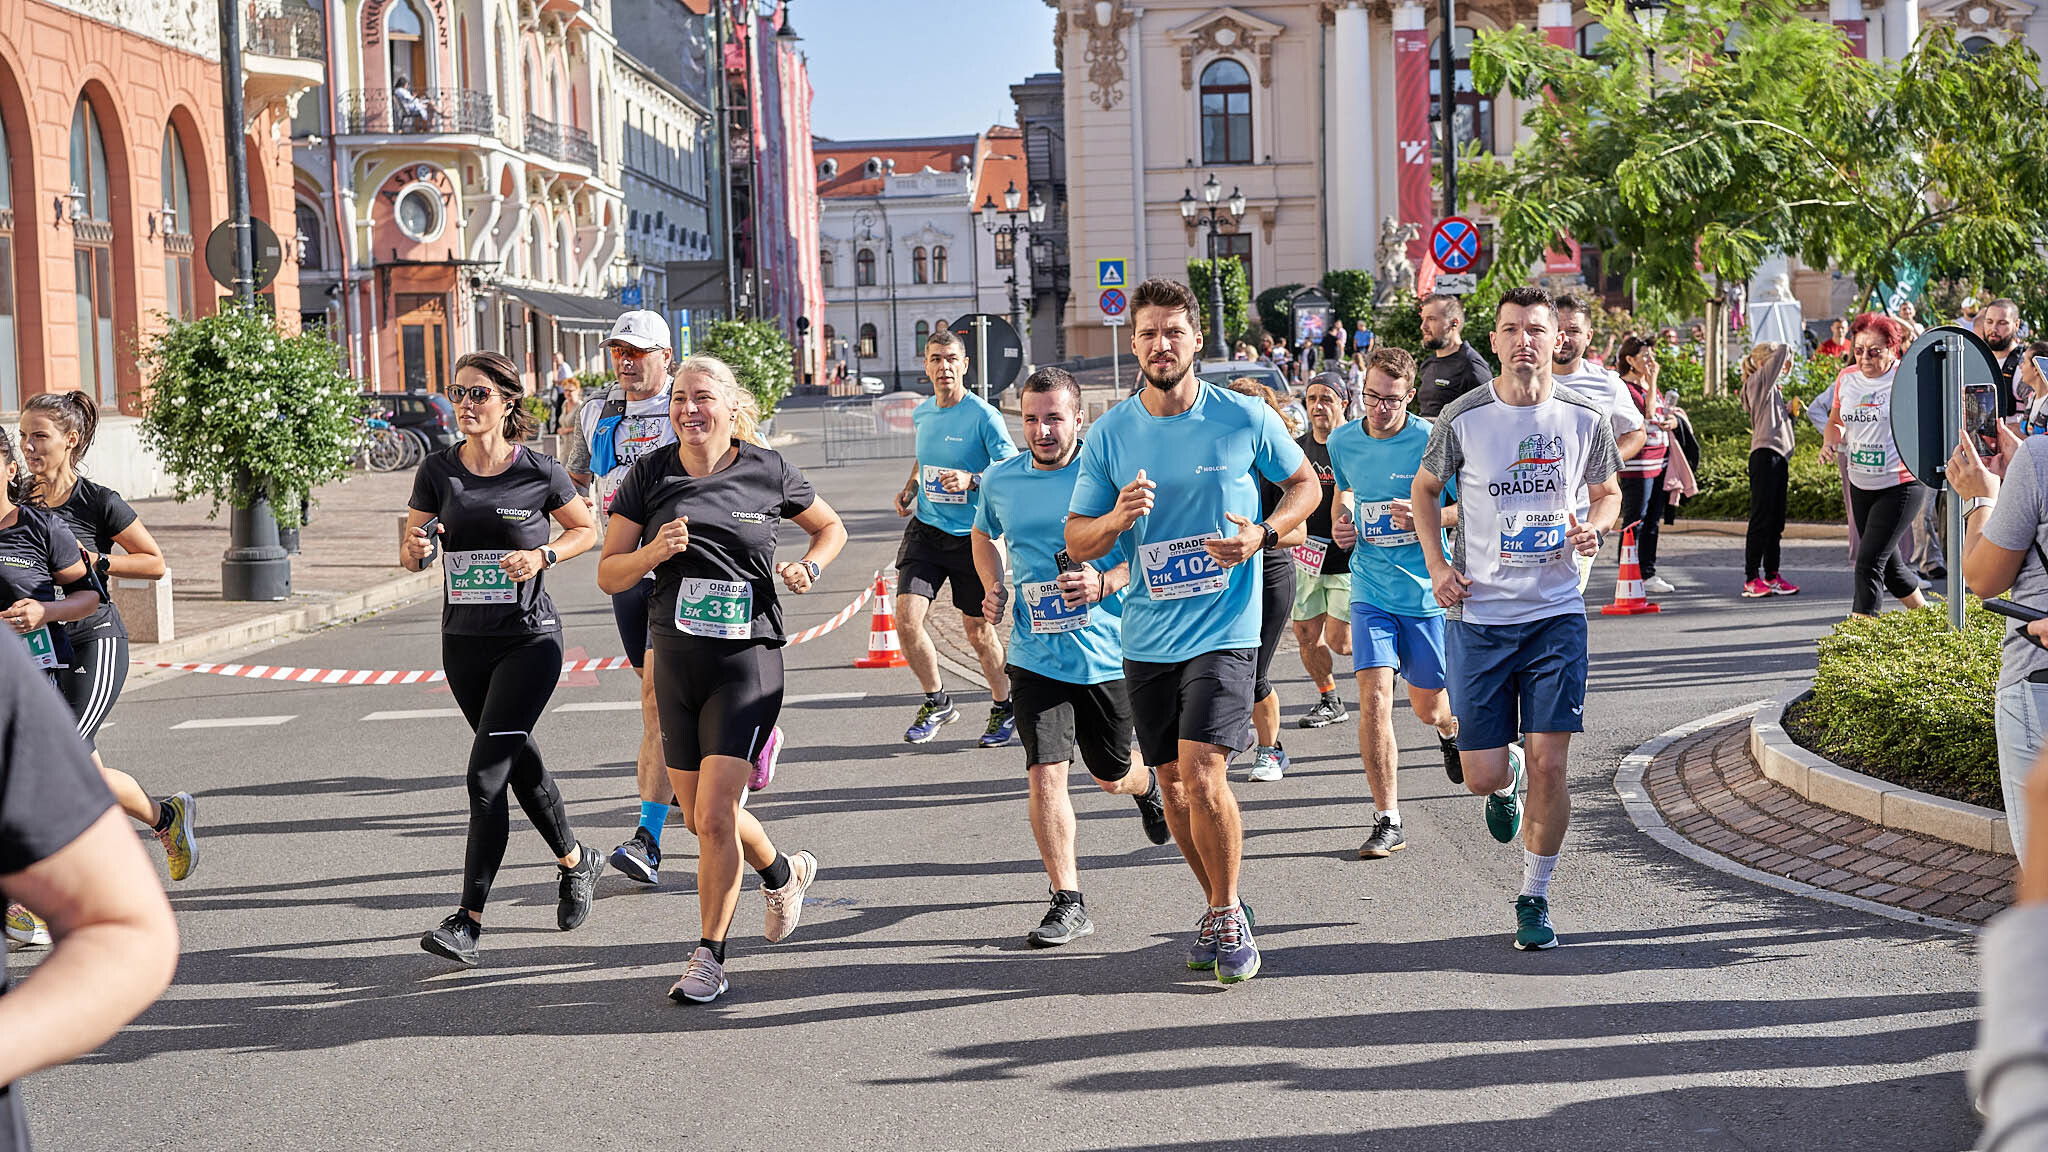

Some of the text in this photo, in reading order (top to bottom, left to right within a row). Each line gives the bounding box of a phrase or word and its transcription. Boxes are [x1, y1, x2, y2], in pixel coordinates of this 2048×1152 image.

[1842, 414, 1878, 423] ORADEA
[1860, 453, 1882, 464] 321
[1488, 479, 1557, 497] ORADEA
[495, 508, 533, 518] creatopy
[1526, 512, 1564, 522] ORADEA
[1367, 526, 1383, 535] 21K
[1534, 529, 1559, 548] 20
[1169, 537, 1211, 551] ORADE
[1503, 540, 1524, 550] 21K
[470, 553, 503, 561] ORADE
[1301, 549, 1321, 565] 190
[1174, 555, 1219, 577] 102
[473, 568, 508, 585] 337
[1151, 572, 1173, 585] 21K
[455, 579, 470, 588] 5K
[709, 583, 749, 593] ORADEA
[1040, 583, 1060, 593] ORA
[684, 607, 702, 618] 5K
[707, 600, 746, 619] 331
[1033, 609, 1047, 619] 21K
